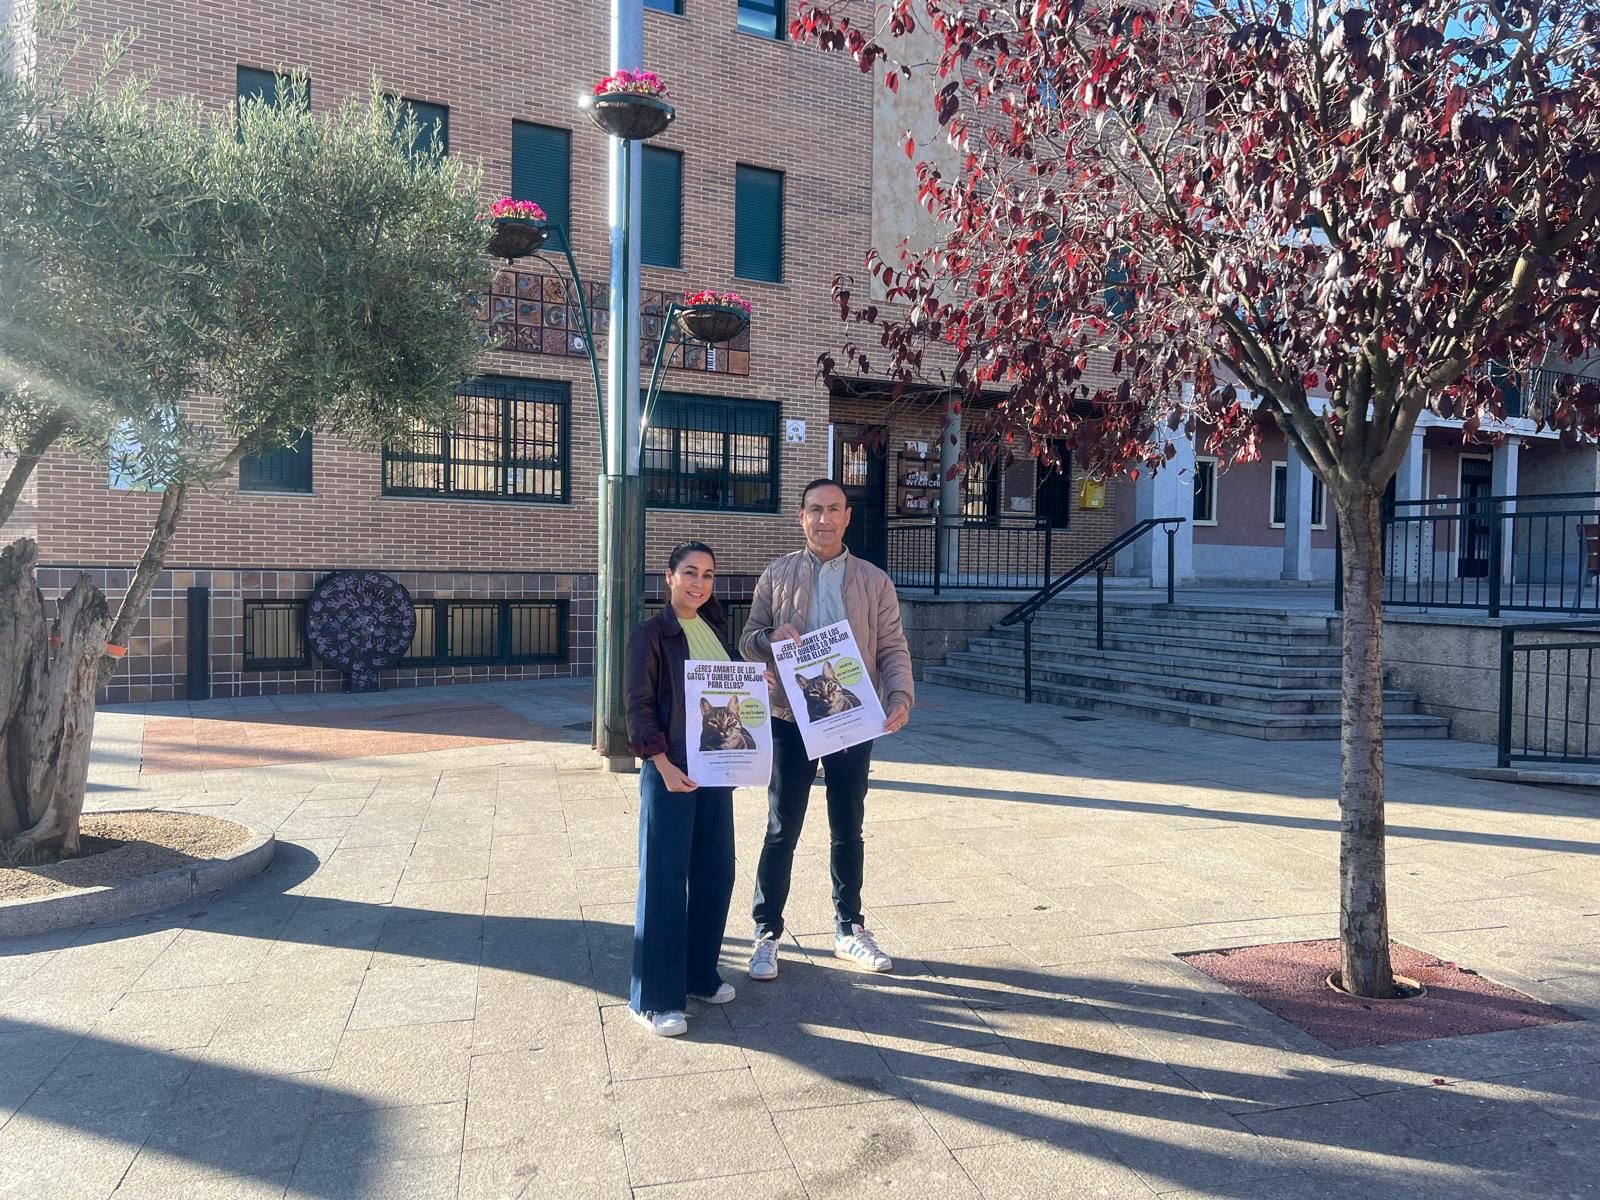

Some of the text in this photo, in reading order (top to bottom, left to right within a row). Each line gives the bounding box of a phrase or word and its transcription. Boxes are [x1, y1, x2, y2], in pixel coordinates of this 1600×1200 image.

[776, 651, 793, 662] GATOS
[798, 643, 820, 655] QUIERES
[829, 632, 849, 645] MEJOR
[781, 642, 796, 652] ¿ERES
[828, 628, 840, 637] LOS
[796, 655, 812, 664] PARA
[812, 647, 832, 659] ELLOS?
